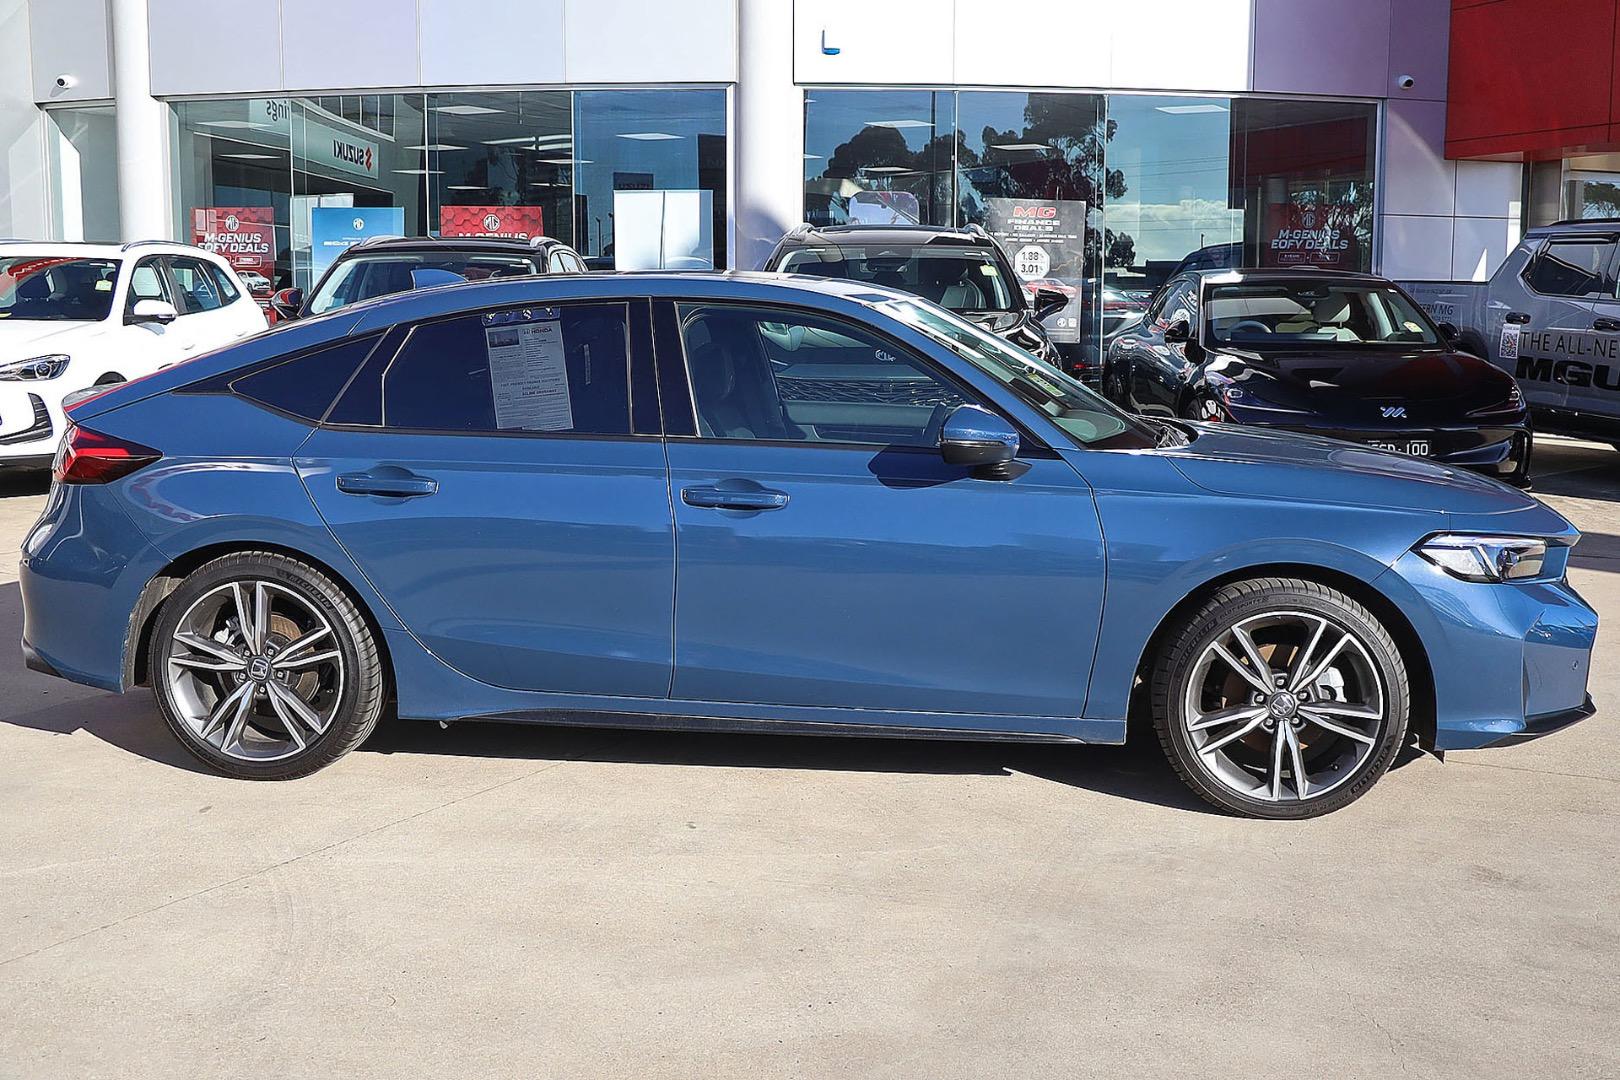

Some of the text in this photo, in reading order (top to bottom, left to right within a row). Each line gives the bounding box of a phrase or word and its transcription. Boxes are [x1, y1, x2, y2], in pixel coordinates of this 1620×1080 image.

[1013, 206, 1056, 218] MG
[230, 243, 269, 252] DEALS
[1271, 240, 1348, 249] EOFY DEALS
[1439, 305, 1454, 315] MG
[1521, 332, 1550, 352] THE
[1406, 443, 1428, 456] 100
